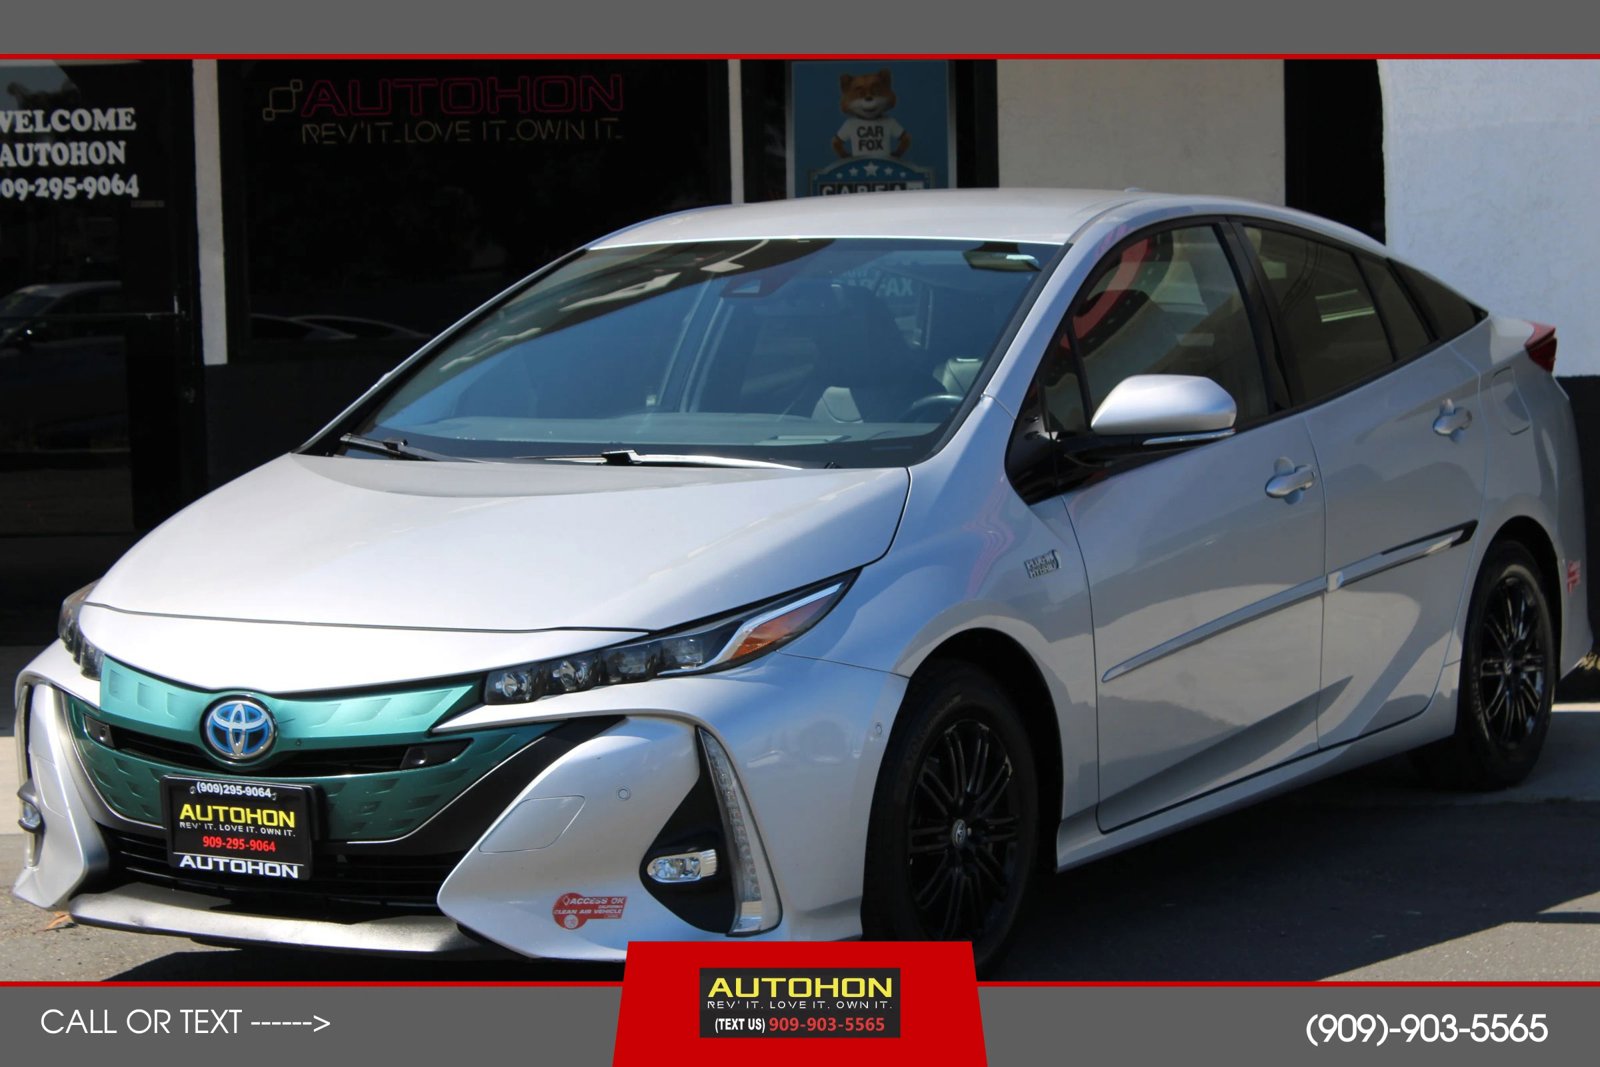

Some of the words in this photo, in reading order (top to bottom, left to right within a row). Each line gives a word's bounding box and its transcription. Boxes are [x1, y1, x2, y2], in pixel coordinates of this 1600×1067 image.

[300, 74, 623, 118] AUTOHON
[404, 120, 471, 143] LOVE
[516, 118, 585, 142] OWN
[857, 126, 884, 139] CAR
[0, 140, 126, 168] AUTOHON
[858, 139, 884, 152] FOX
[0, 173, 139, 201] 09-295-9064
[197, 781, 272, 798] (909)295-9064
[179, 803, 296, 828] AUTOHON
[219, 824, 244, 833] LOVE
[260, 827, 281, 836] OWN
[202, 835, 276, 853] 909-295-9064
[180, 854, 299, 879] AUTOHON
[570, 897, 608, 905] ACCESS
[611, 897, 625, 905] OK
